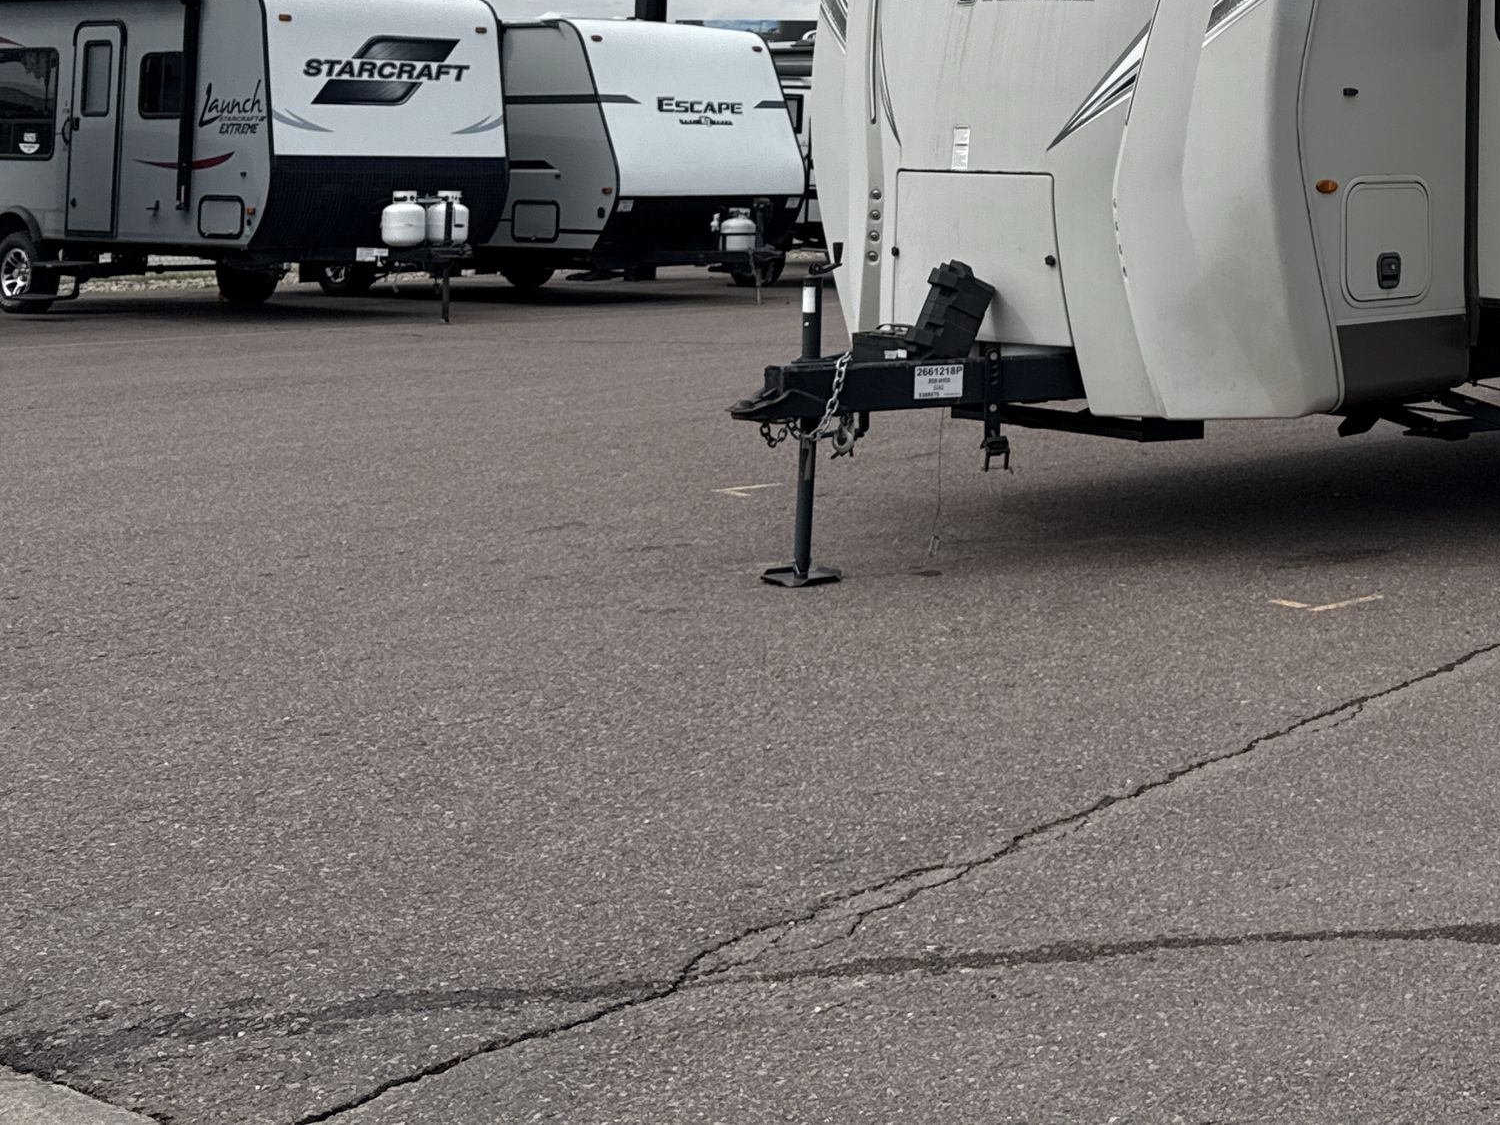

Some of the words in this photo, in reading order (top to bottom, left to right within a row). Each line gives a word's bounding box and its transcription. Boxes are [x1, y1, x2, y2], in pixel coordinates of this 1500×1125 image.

[303, 58, 471, 82] STARCRAFT
[198, 78, 263, 128] Launch
[656, 96, 744, 115] ESCAPE
[219, 123, 260, 135] EXTREME
[916, 366, 963, 377] 2661218P
